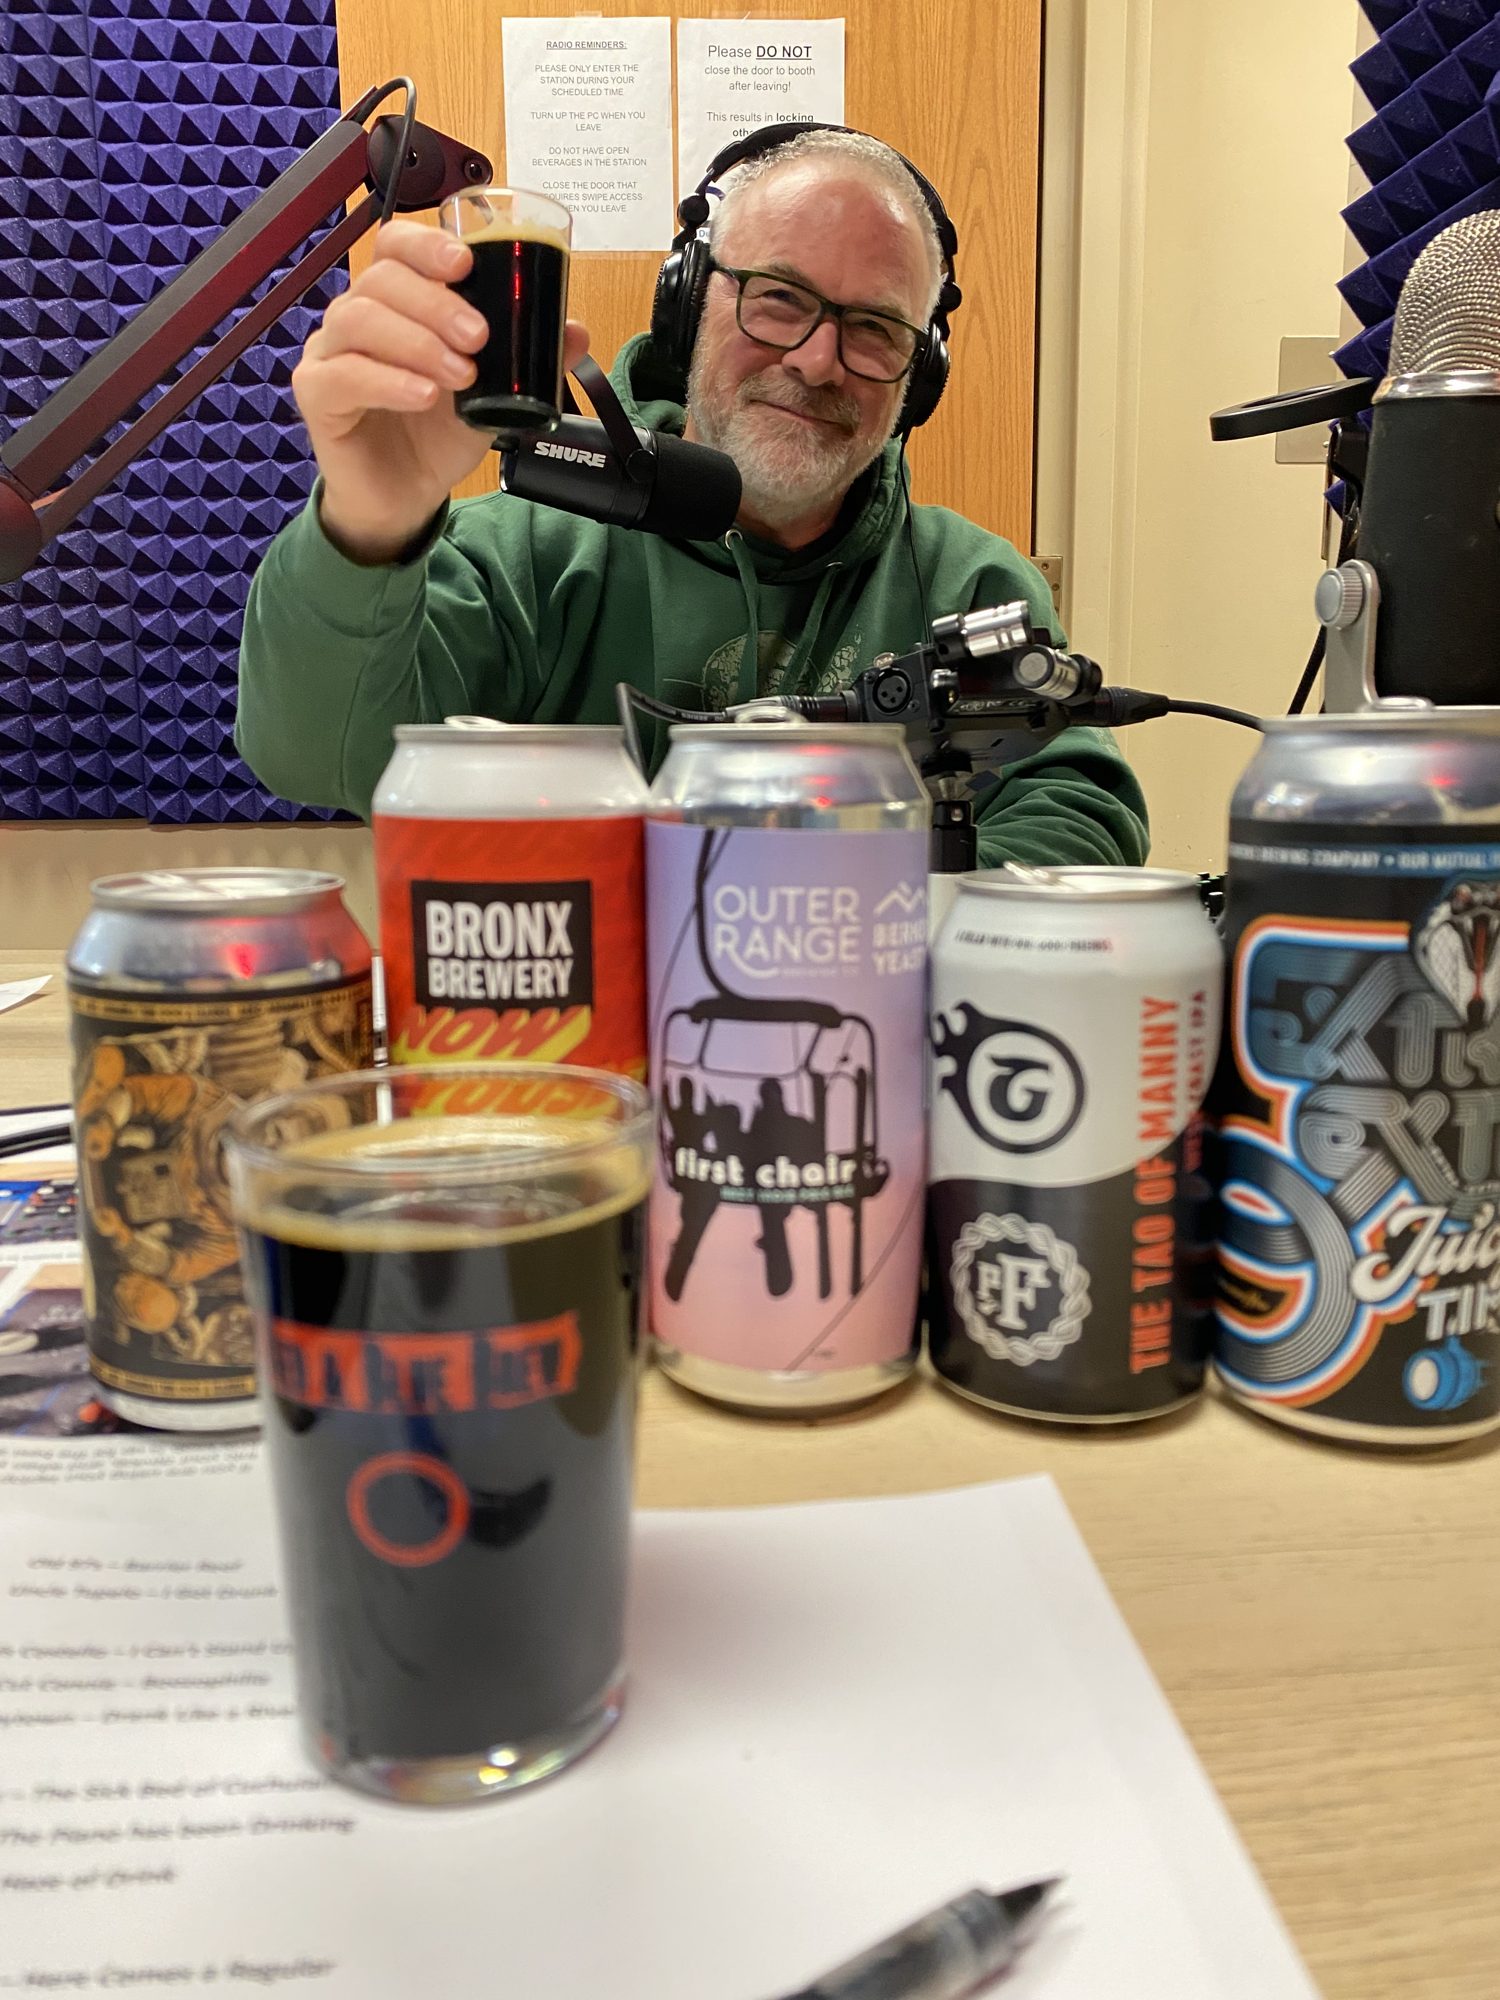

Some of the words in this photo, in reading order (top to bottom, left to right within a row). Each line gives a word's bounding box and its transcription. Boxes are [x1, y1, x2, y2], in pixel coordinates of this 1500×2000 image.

[546, 41, 573, 50] RADIO
[575, 41, 628, 50] REMINDERS:
[708, 45, 752, 58] Please
[756, 45, 778, 58] DO
[782, 45, 812, 58] NOT
[535, 64, 567, 72] PLEASE
[568, 64, 591, 72] ONLY
[593, 64, 621, 72] ENTER
[623, 64, 639, 72] THE
[704, 65, 730, 75] close
[733, 66, 748, 75] the
[751, 66, 773, 75] door
[776, 66, 785, 75] to
[788, 66, 816, 75] booth
[540, 76, 574, 84] STATION
[576, 76, 609, 84] DURING
[611, 76, 635, 84] YOUR
[551, 88, 602, 96] SCHEDULED
[604, 88, 624, 96] TIME
[729, 81, 751, 91] after
[753, 81, 791, 93] leaving!
[531, 111, 554, 119] TURN
[555, 111, 567, 119] UP
[569, 111, 585, 119] THE
[587, 111, 599, 119] PC
[600, 111, 626, 119] WHEN
[627, 111, 646, 119] YOU
[707, 111, 727, 121] This
[730, 111, 762, 121] results
[764, 112, 773, 121] in
[776, 112, 814, 122] locking
[575, 123, 602, 131] LEAVE
[549, 147, 562, 155] DO
[563, 147, 581, 155] NOT
[582, 147, 604, 155] HAVE
[606, 147, 630, 155] OPEN
[532, 158, 582, 166] BEVERAGES
[584, 158, 593, 166] IN
[595, 158, 611, 166] THE
[612, 158, 647, 166] STATION
[542, 181, 570, 189] CLOSE
[572, 181, 588, 189] THE
[590, 181, 615, 189] DOOR
[617, 181, 638, 189] THAT
[540, 193, 580, 201] EQUIRES
[581, 193, 608, 201] SWIPE
[609, 193, 643, 201] ACCESS
[534, 441, 607, 468] SHURE
[713, 885, 861, 924] OUTER
[425, 900, 574, 959] BRONX
[713, 923, 863, 979] RANGE
[427, 957, 574, 999] BREWERY
[398, 1003, 592, 1060] NOW
[1137, 994, 1180, 1142] MANNY
[675, 1147, 743, 1186] first
[755, 1152, 857, 1189] chair
[1133, 1154, 1177, 1206] OF
[1131, 1213, 1175, 1294] TAO
[1129, 1297, 1173, 1374] THE
